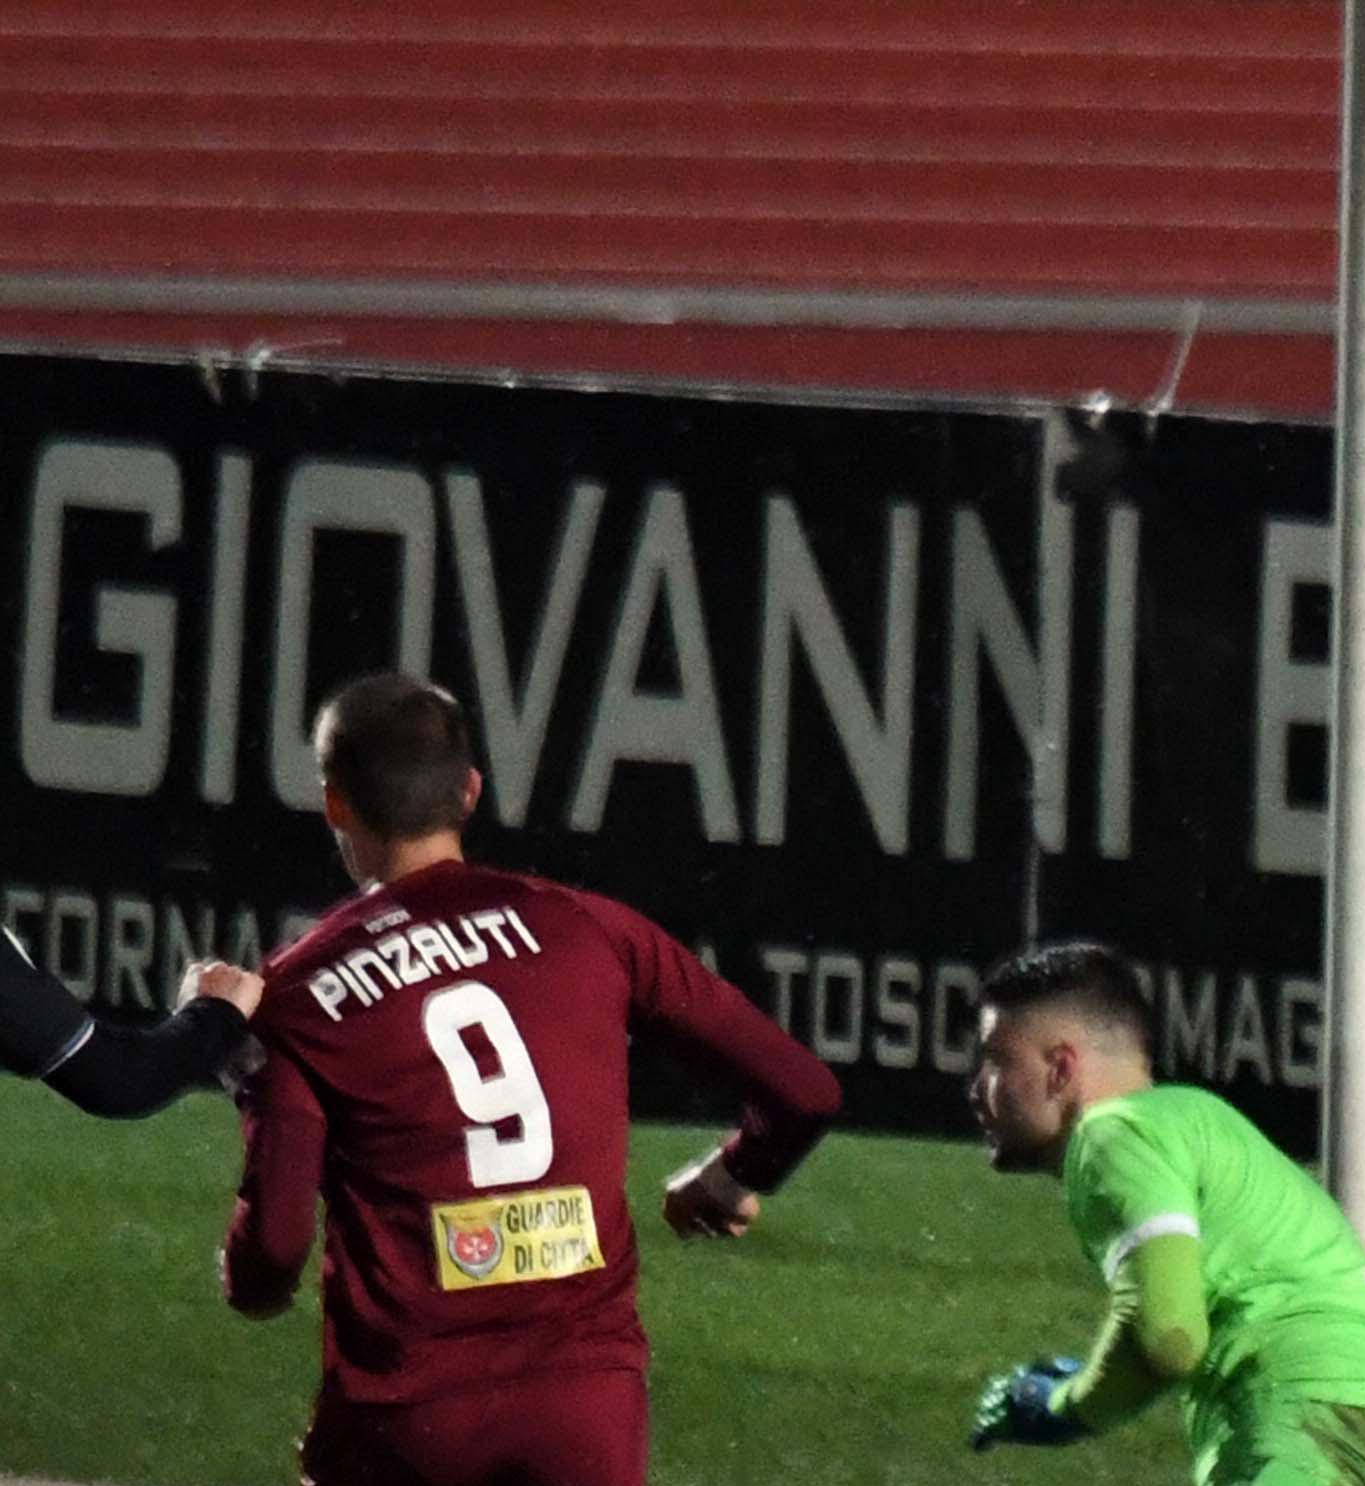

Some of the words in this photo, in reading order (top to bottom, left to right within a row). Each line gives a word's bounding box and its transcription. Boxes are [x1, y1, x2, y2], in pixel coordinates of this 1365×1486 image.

[20, 440, 1141, 863] GIOVANNI
[422, 979, 554, 1188] 9
[514, 1243, 533, 1275] DI
